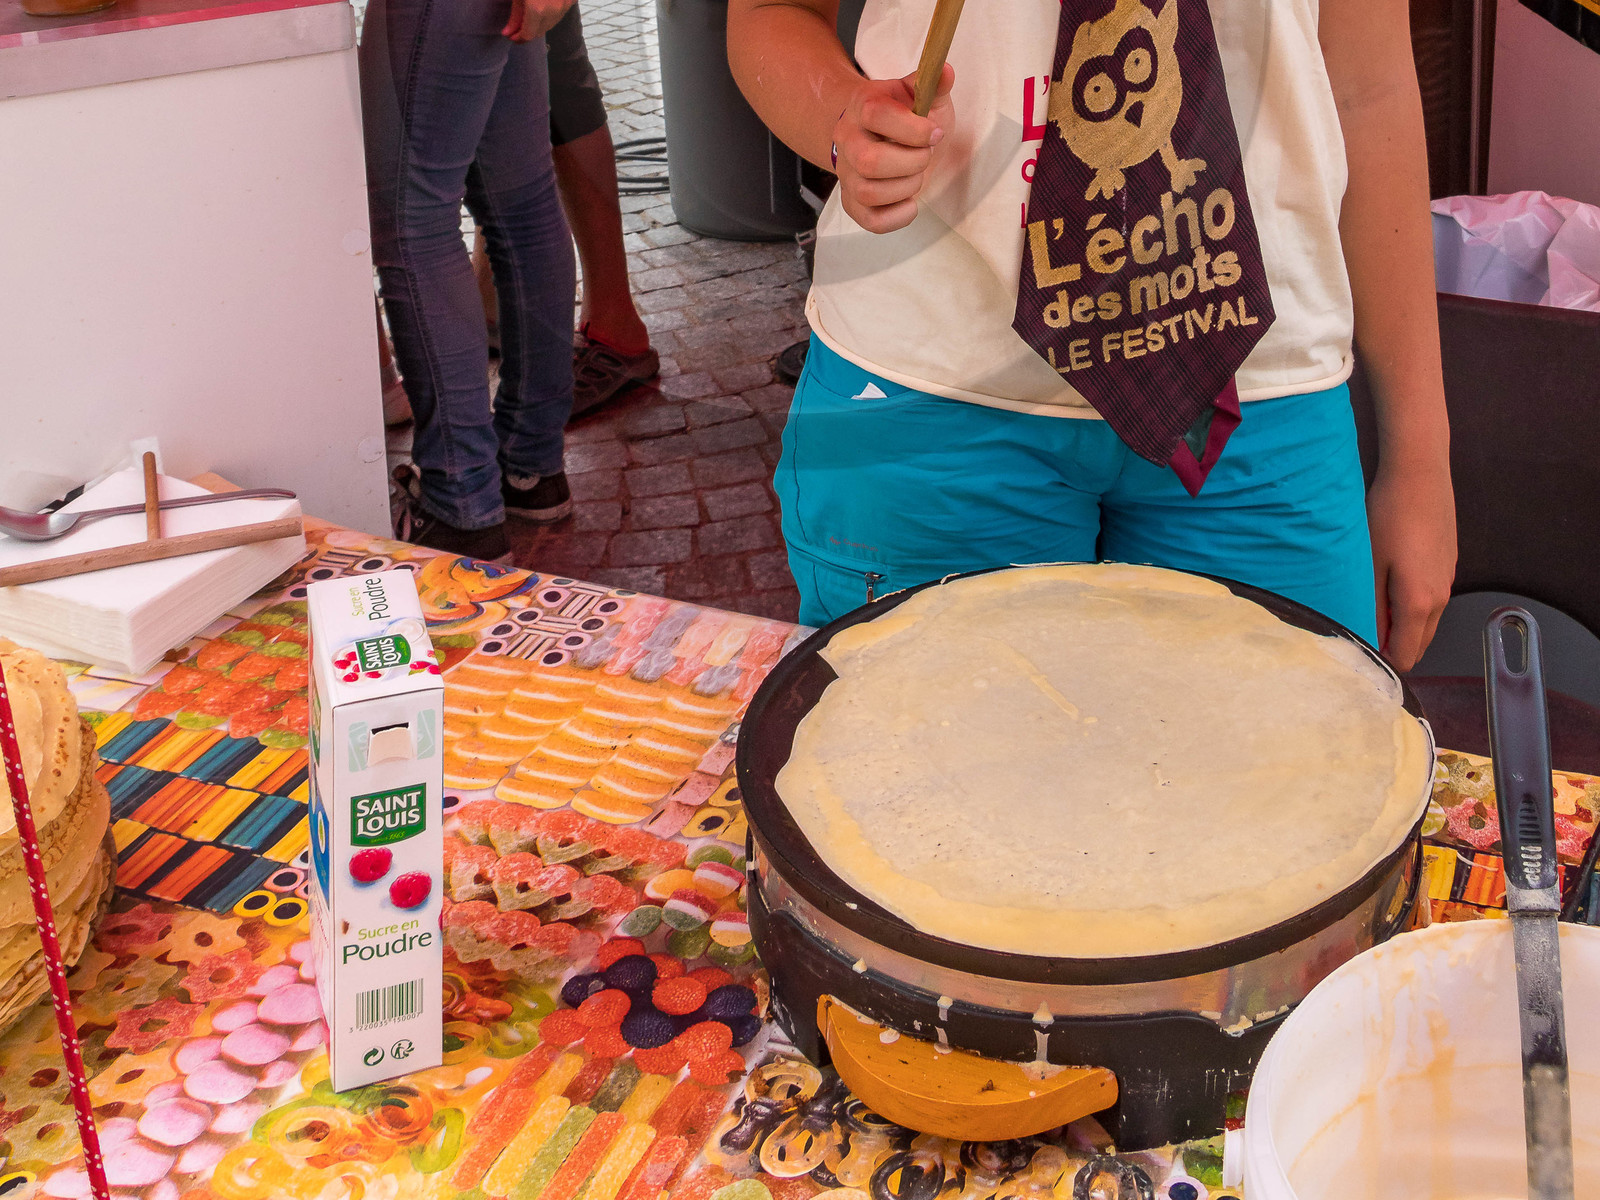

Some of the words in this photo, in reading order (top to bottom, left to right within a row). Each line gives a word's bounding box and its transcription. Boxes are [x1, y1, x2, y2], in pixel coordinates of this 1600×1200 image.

[1028, 188, 1235, 289] L'écho
[1043, 289, 1122, 328] des
[1129, 246, 1242, 315] mots
[1048, 338, 1093, 374] LE
[1102, 296, 1258, 363] FESTIVAL
[349, 587, 360, 596] en
[363, 578, 390, 620] Poudre
[352, 597, 365, 616] Sucre
[363, 641, 382, 669] SAINT
[379, 638, 402, 666] LOUIS
[356, 791, 421, 818] SAINT
[356, 808, 420, 837] LOUIS
[358, 924, 398, 940] Sucre
[401, 919, 419, 931] en
[343, 932, 432, 964] Poudre
